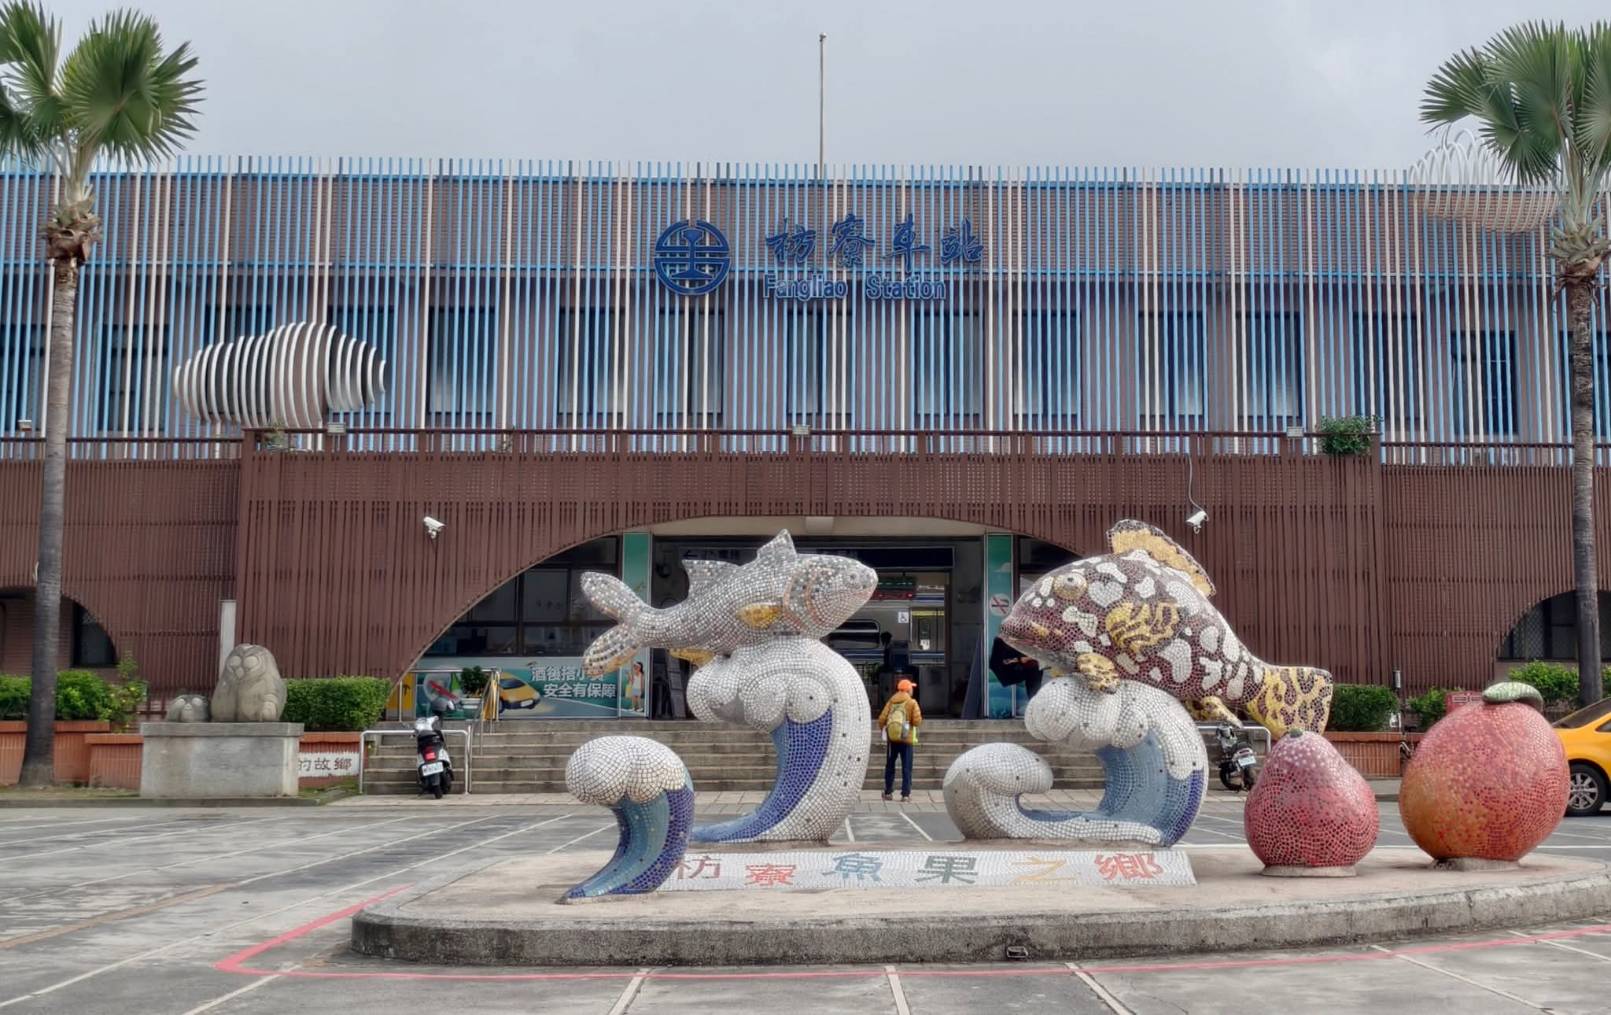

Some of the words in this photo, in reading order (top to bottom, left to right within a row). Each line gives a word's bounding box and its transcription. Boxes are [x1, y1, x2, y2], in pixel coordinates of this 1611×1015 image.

[766, 213, 984, 273] 枋寮車站
[764, 273, 848, 300] Fangliao
[866, 275, 946, 299] Station
[532, 665, 603, 681] 酒後搭小
[543, 682, 616, 698] 安全有保障
